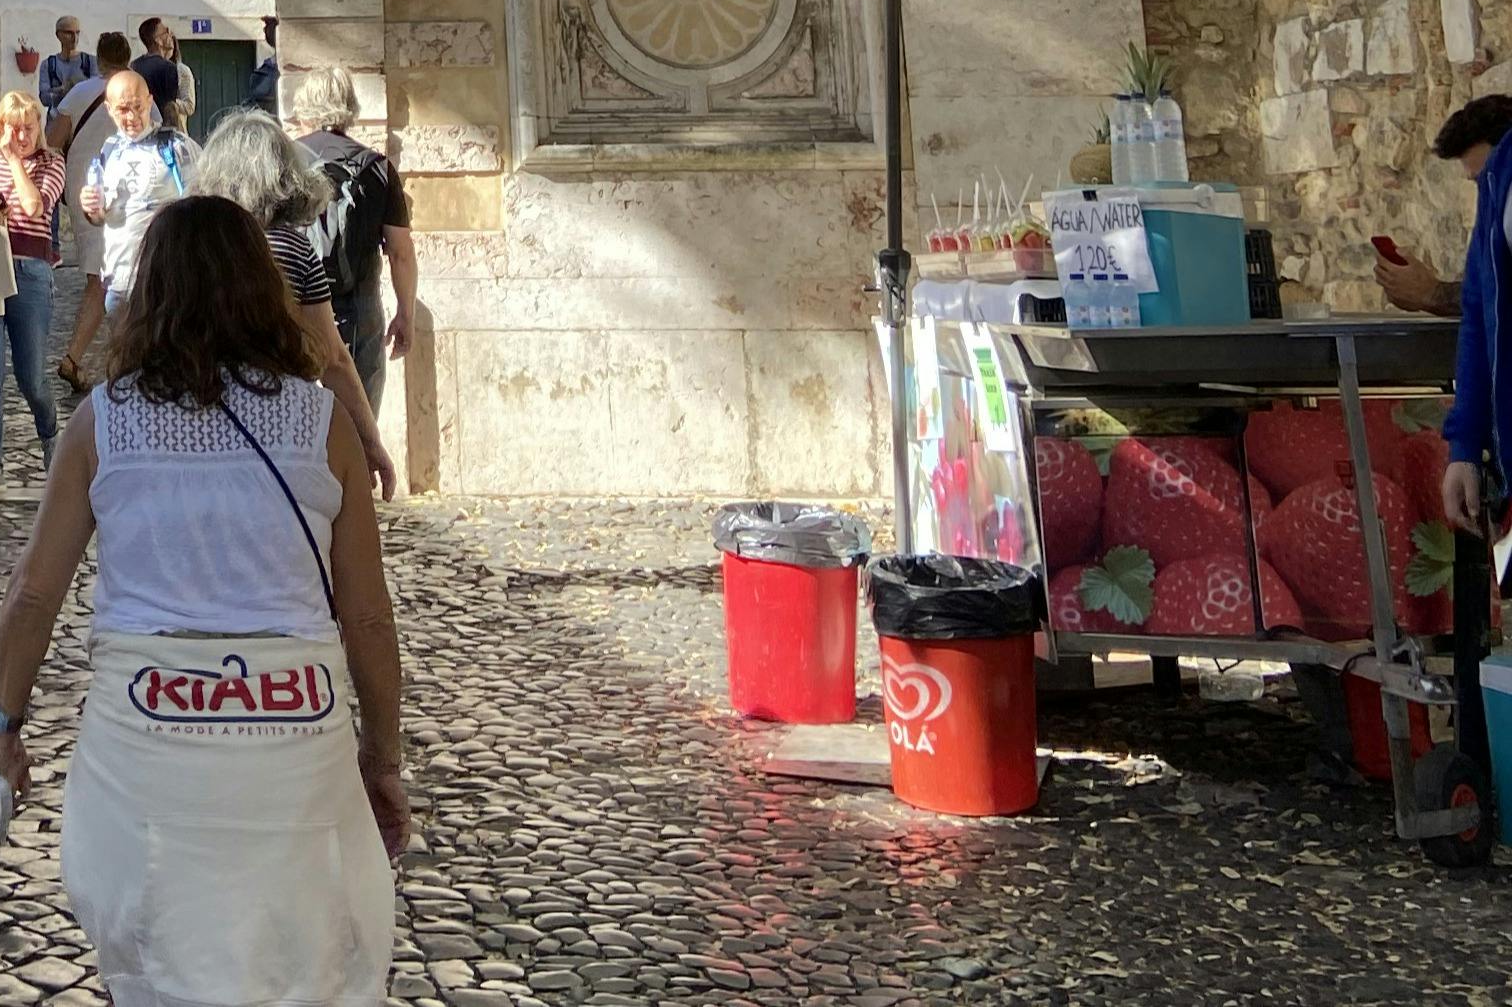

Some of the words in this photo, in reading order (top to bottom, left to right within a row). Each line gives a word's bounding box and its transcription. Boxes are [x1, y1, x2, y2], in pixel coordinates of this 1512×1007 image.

[146, 664, 321, 712] KIABI
[146, 724, 163, 733] LA
[170, 725, 215, 736] MODE
[238, 725, 286, 736] PETITS
[292, 725, 325, 737] PRIX
[890, 720, 936, 756] OLÁ
